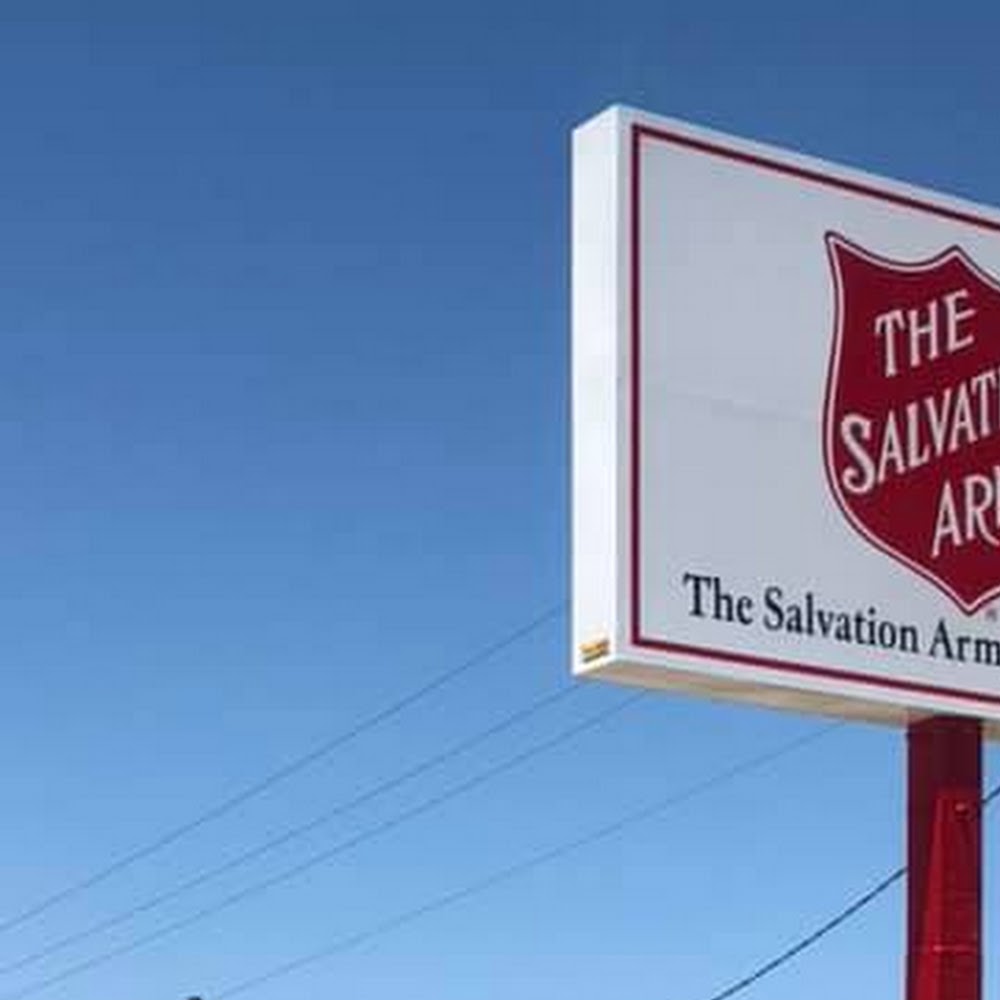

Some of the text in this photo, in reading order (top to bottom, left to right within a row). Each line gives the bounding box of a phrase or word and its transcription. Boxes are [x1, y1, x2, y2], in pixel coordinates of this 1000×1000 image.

[874, 289, 977, 377] THE
[683, 573, 754, 625] The
[763, 586, 919, 653] Salvation
